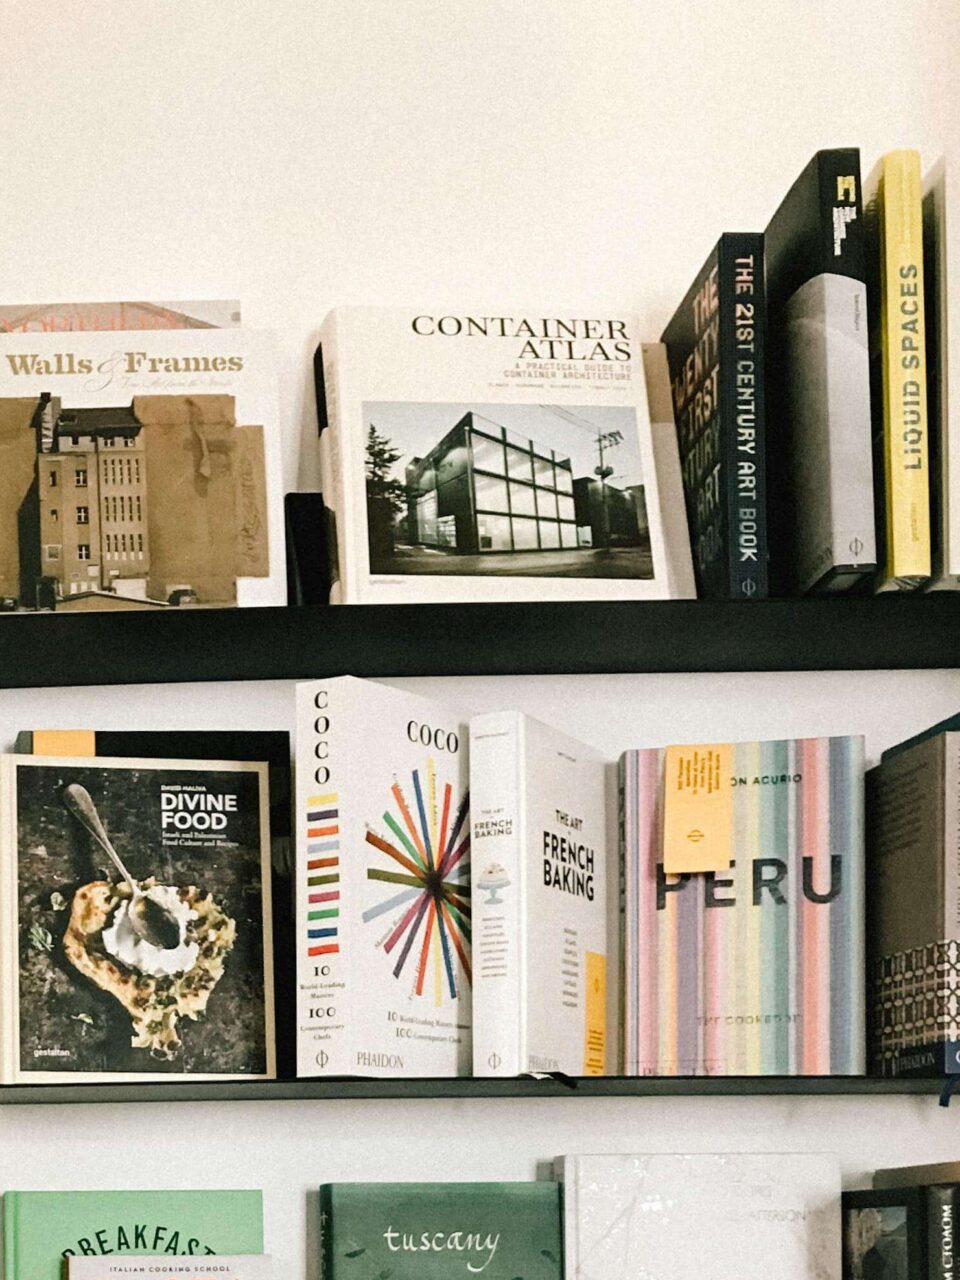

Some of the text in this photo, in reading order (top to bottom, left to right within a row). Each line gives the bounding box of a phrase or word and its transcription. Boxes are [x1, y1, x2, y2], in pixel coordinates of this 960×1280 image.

[411, 315, 632, 341] CONTAINER
[6, 351, 244, 376] Walls Frames
[517, 340, 632, 362] ATLAS
[899, 263, 923, 471] LIQUID SPACES
[734, 254, 758, 563] THE 21ST CENTURY ART BOOK
[406, 719, 460, 755] COCO
[752, 773, 803, 786] ACURIO
[161, 793, 238, 811] DIVINE
[161, 811, 228, 830] FOOD
[474, 819, 513, 830] FRENCH
[474, 827, 513, 839] BAKING
[543, 830, 594, 874] FRENCH
[543, 858, 594, 902] BAKING
[654, 854, 843, 912] PERU
[33, 1048, 70, 1058] gestalten
[357, 1051, 404, 1069] PHAIDON
[941, 1203, 954, 1269] СТОЛОМ
[382, 1225, 500, 1273] tuscany
[149, 1265, 191, 1273] COOKING
